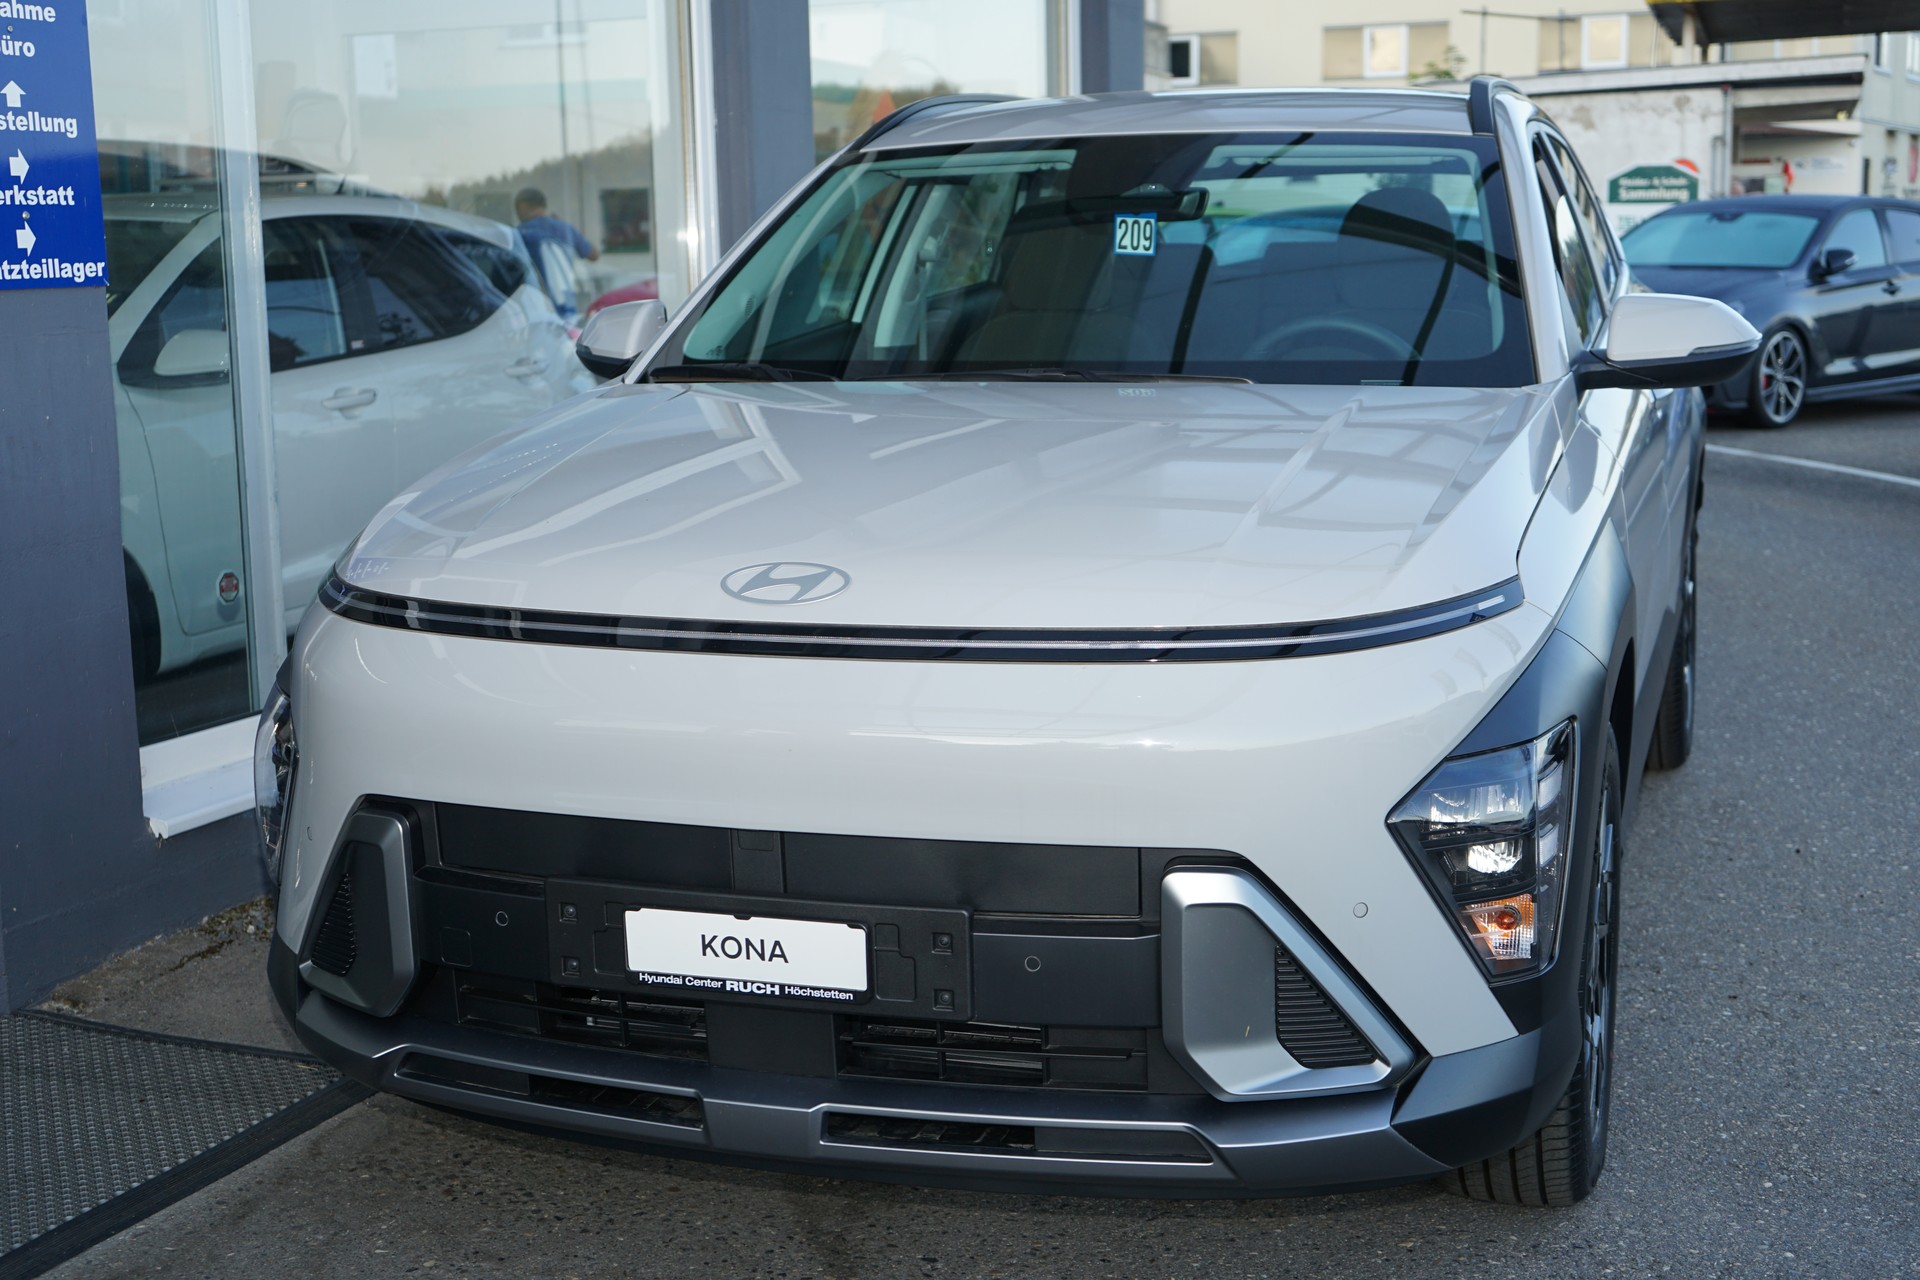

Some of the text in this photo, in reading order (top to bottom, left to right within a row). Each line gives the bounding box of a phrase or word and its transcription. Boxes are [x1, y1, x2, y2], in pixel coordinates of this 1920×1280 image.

[0, 35, 35, 57] üro
[1118, 218, 1153, 251] 209
[0, 258, 105, 283] tzteillager
[701, 934, 789, 963] KONA
[639, 972, 853, 1000] Hyundai Center RUCH Höchstetten
